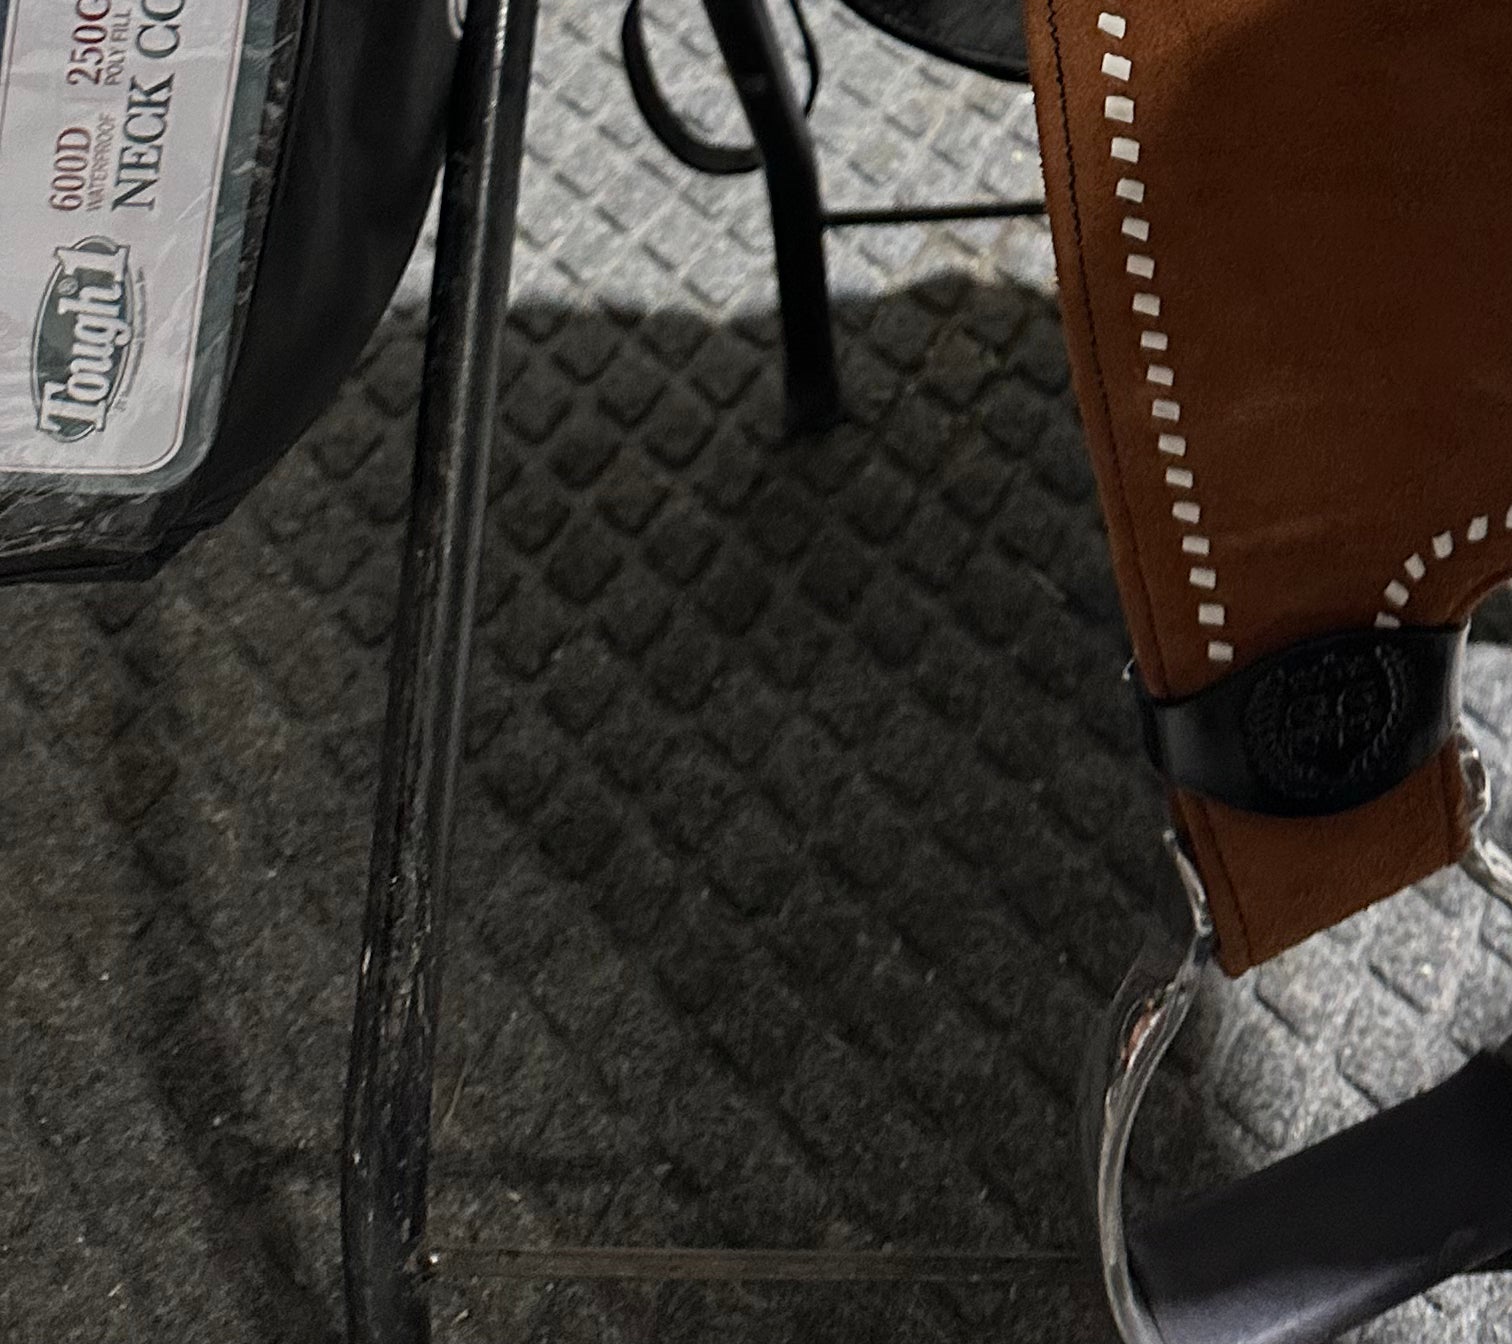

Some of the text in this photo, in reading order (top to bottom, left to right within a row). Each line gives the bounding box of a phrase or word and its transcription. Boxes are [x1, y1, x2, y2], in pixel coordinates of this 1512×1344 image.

[104, 8, 132, 87] POLY FILL
[50, 126, 92, 212] 600D
[86, 113, 115, 212] WATERPROOF
[111, 72, 176, 212] NECK
